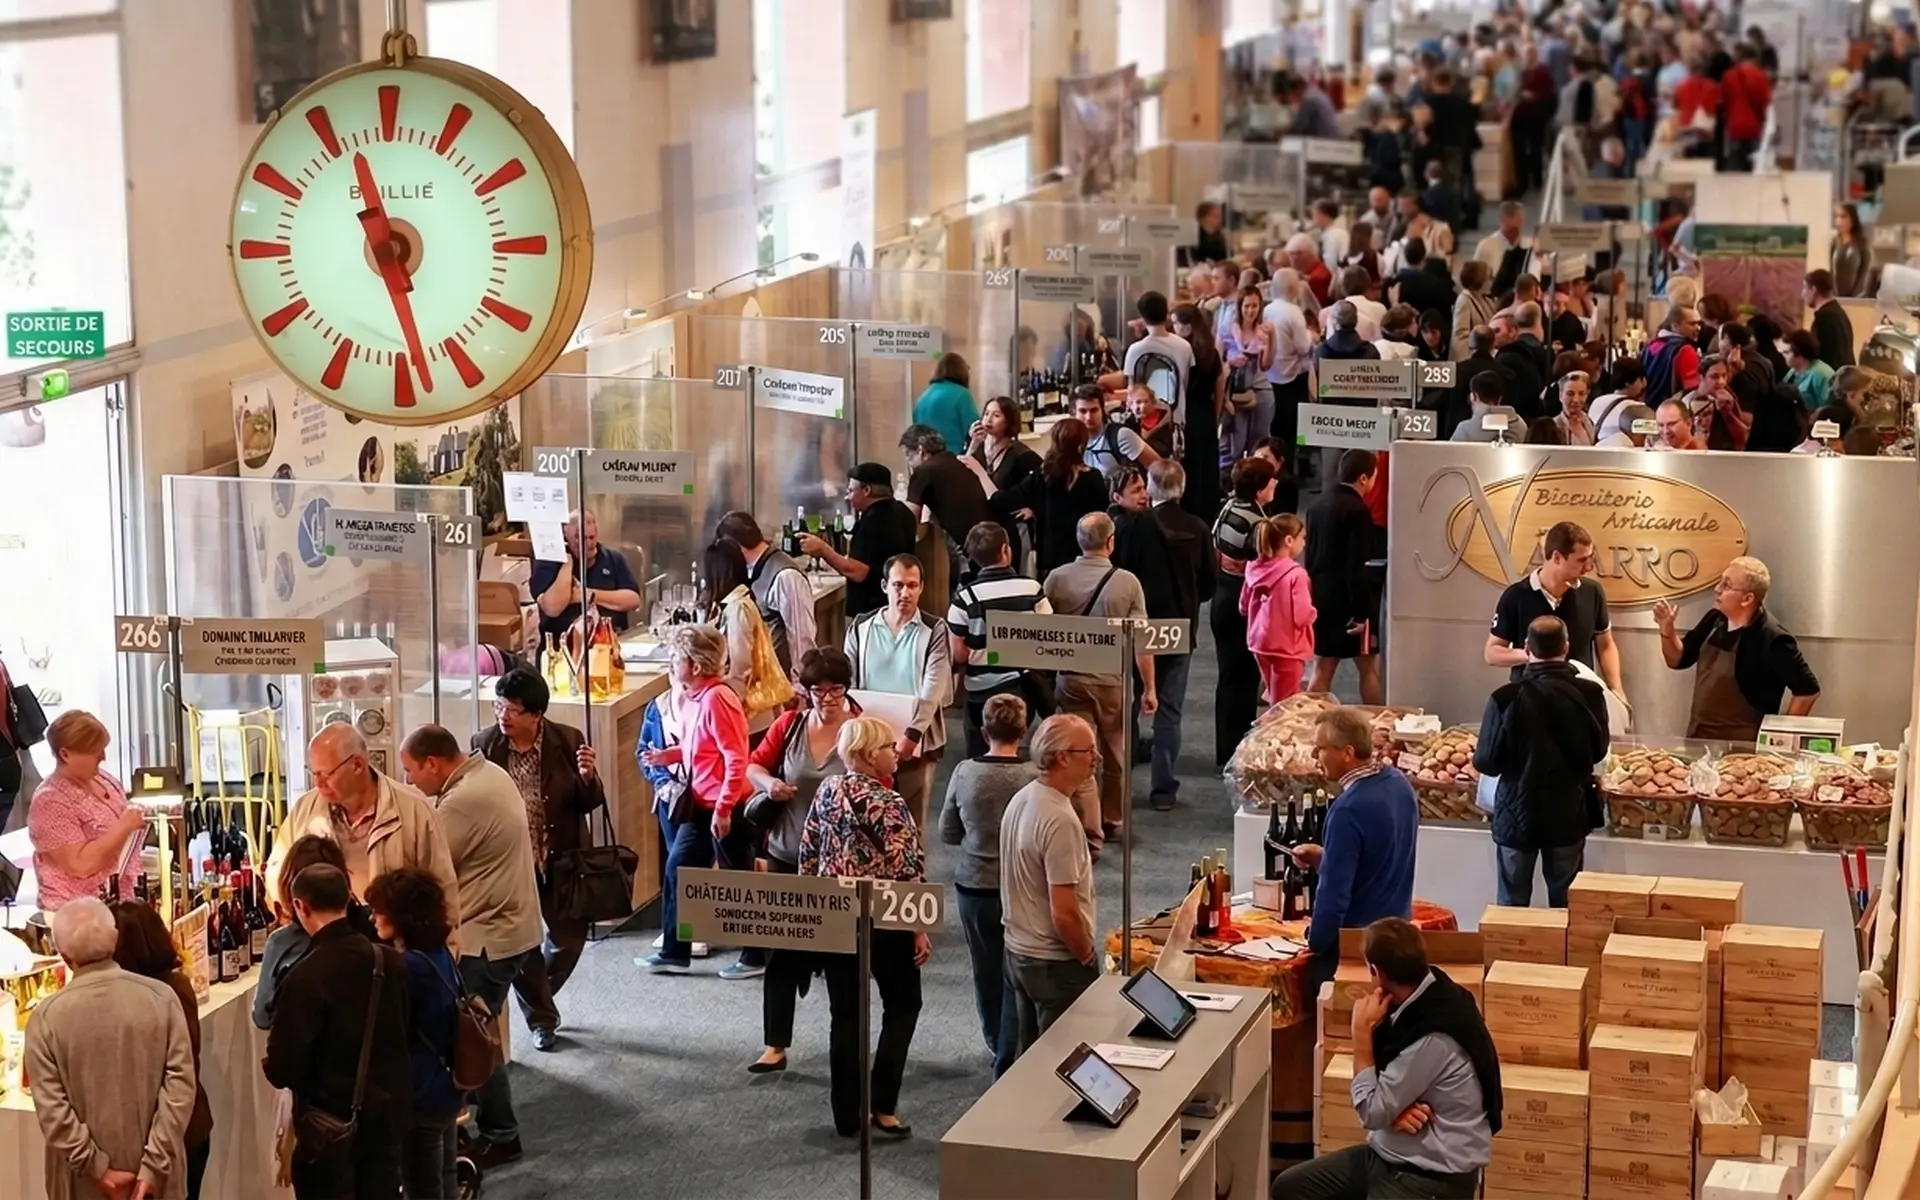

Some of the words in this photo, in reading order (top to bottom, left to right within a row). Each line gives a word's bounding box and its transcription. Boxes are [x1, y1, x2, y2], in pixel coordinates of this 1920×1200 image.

[350, 181, 435, 200] BILLIÉ
[10, 317, 71, 332] SORTIE
[75, 316, 98, 331] DE
[15, 340, 96, 356] SECOURS
[537, 453, 570, 474] 200
[445, 523, 472, 545] 261
[120, 623, 162, 648] 266
[1144, 626, 1182, 649] 259
[881, 890, 938, 925] 260
